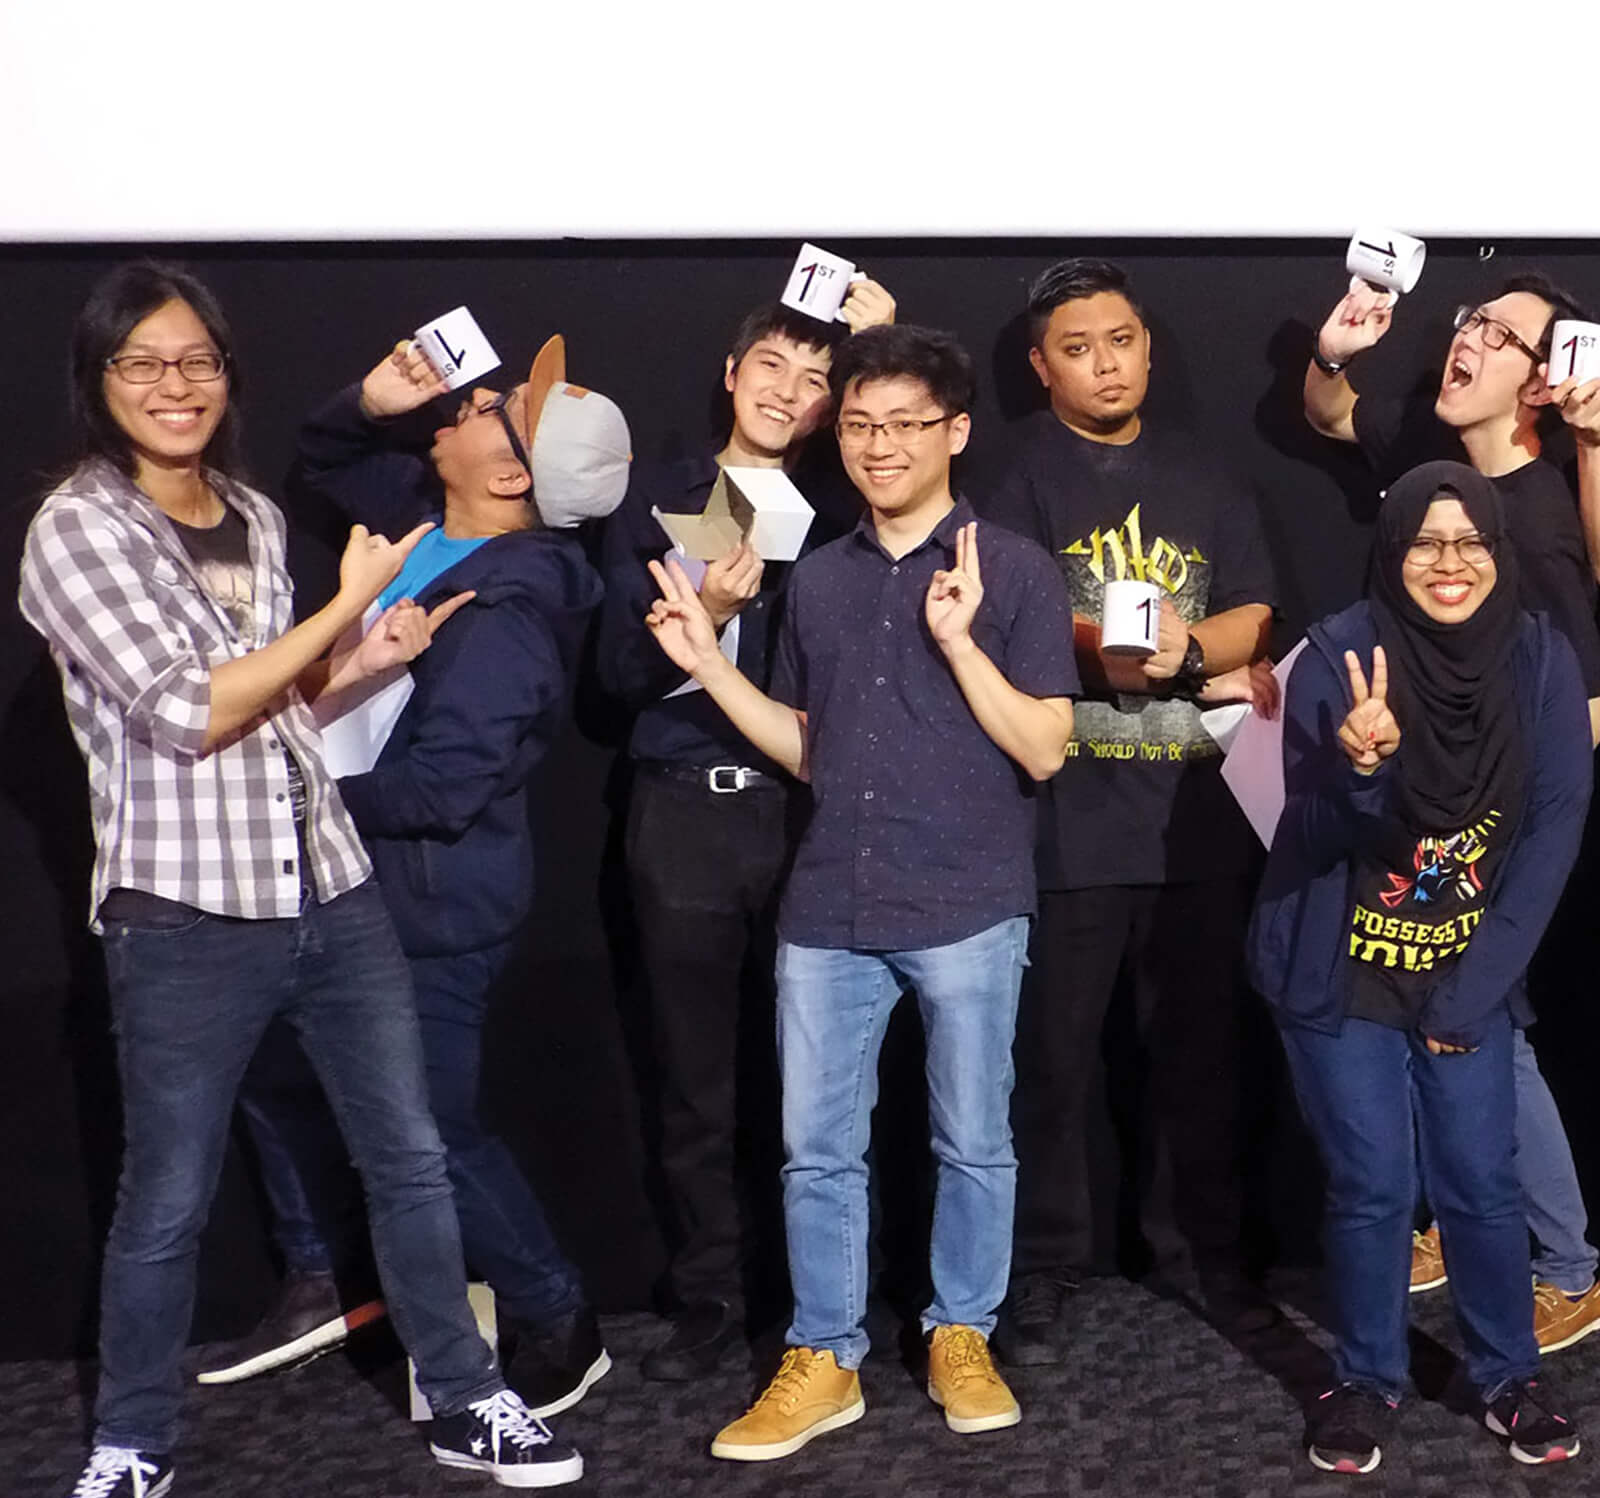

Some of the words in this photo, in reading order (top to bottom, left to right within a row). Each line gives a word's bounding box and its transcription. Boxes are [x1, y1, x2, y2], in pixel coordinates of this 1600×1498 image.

[1358, 240, 1397, 277] 1ST
[798, 261, 837, 303] 1ST
[433, 328, 466, 378] 1S
[1561, 335, 1597, 377] 1ST
